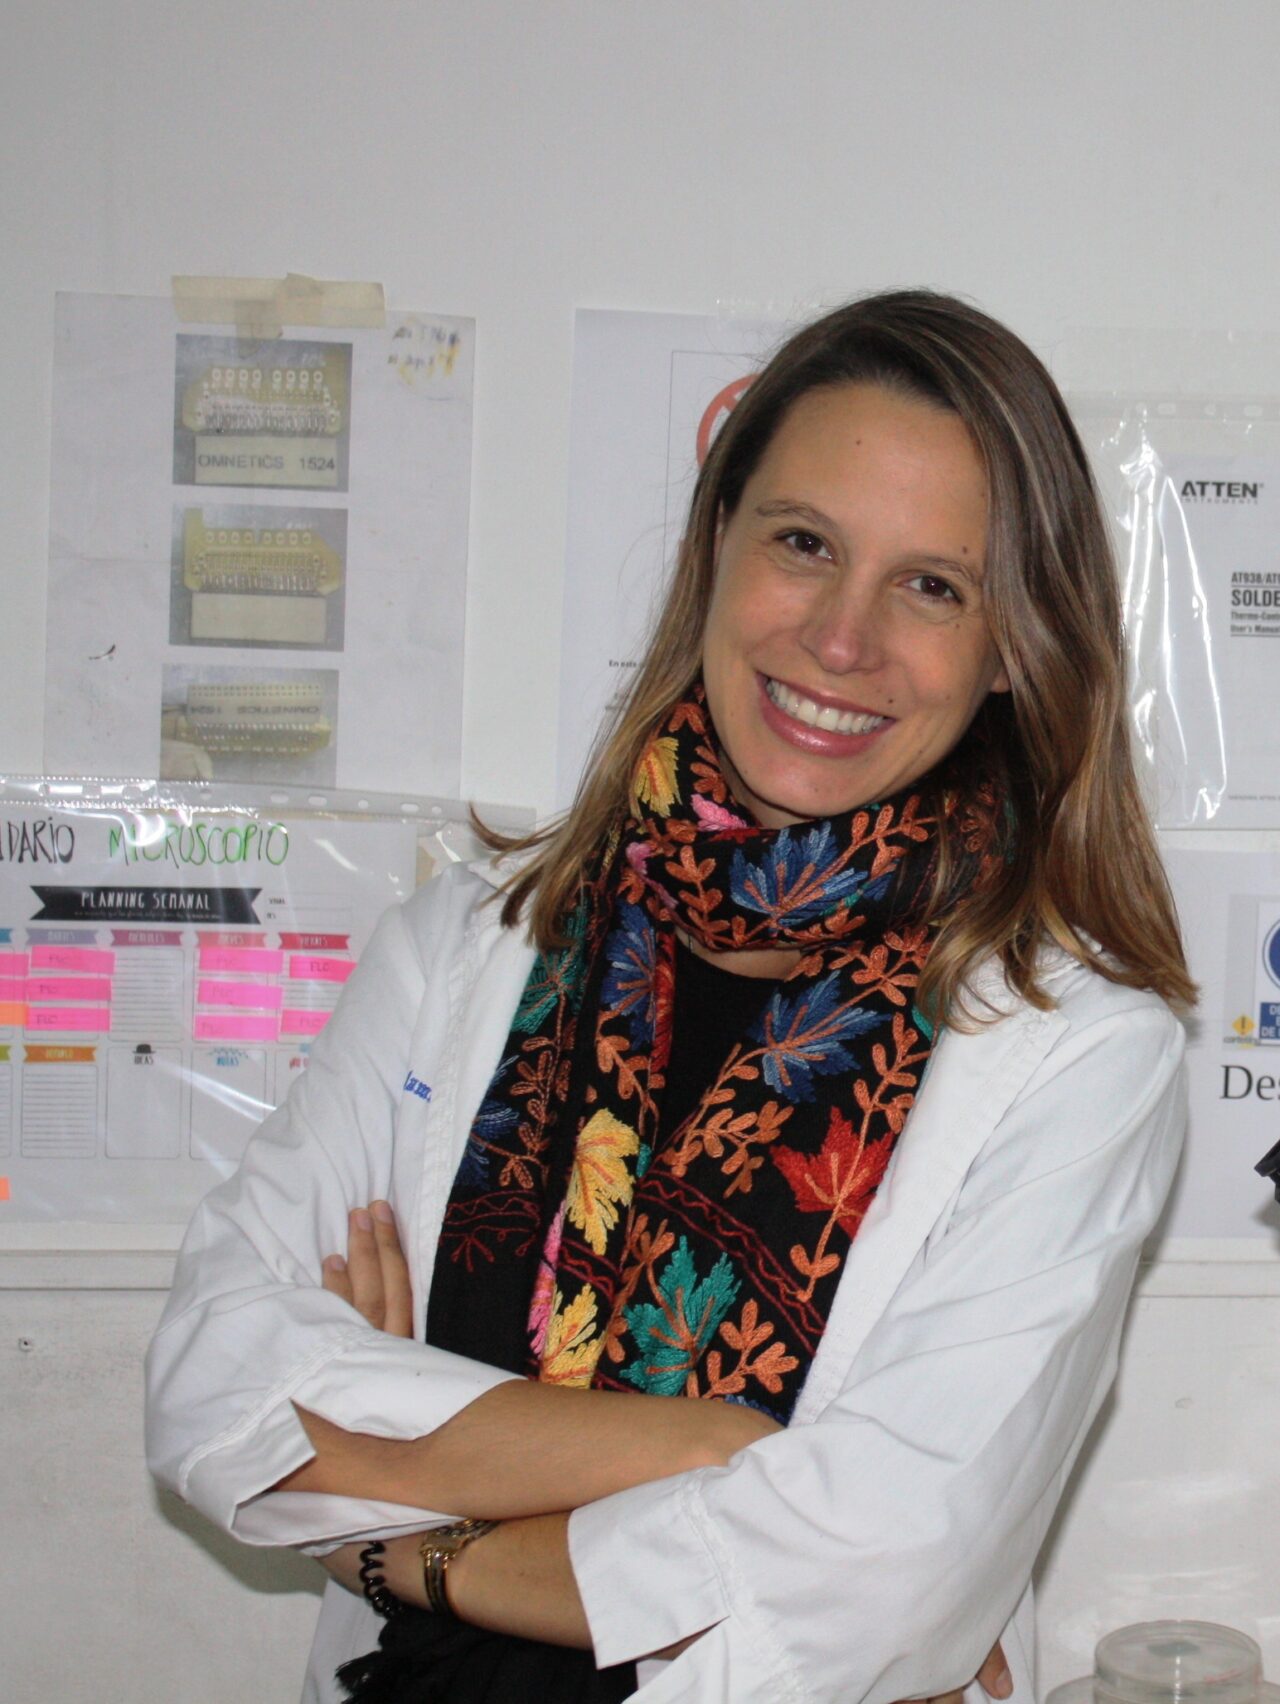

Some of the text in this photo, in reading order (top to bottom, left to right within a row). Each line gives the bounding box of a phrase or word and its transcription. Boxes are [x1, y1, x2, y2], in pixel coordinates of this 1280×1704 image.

[197, 454, 336, 471] OMNETICS 1524
[1181, 480, 1258, 498] ATTEN
[80, 890, 211, 910] PLANNING SEMANAL
[1261, 1026, 1275, 1037] DE
[134, 1055, 154, 1065] IDEAS
